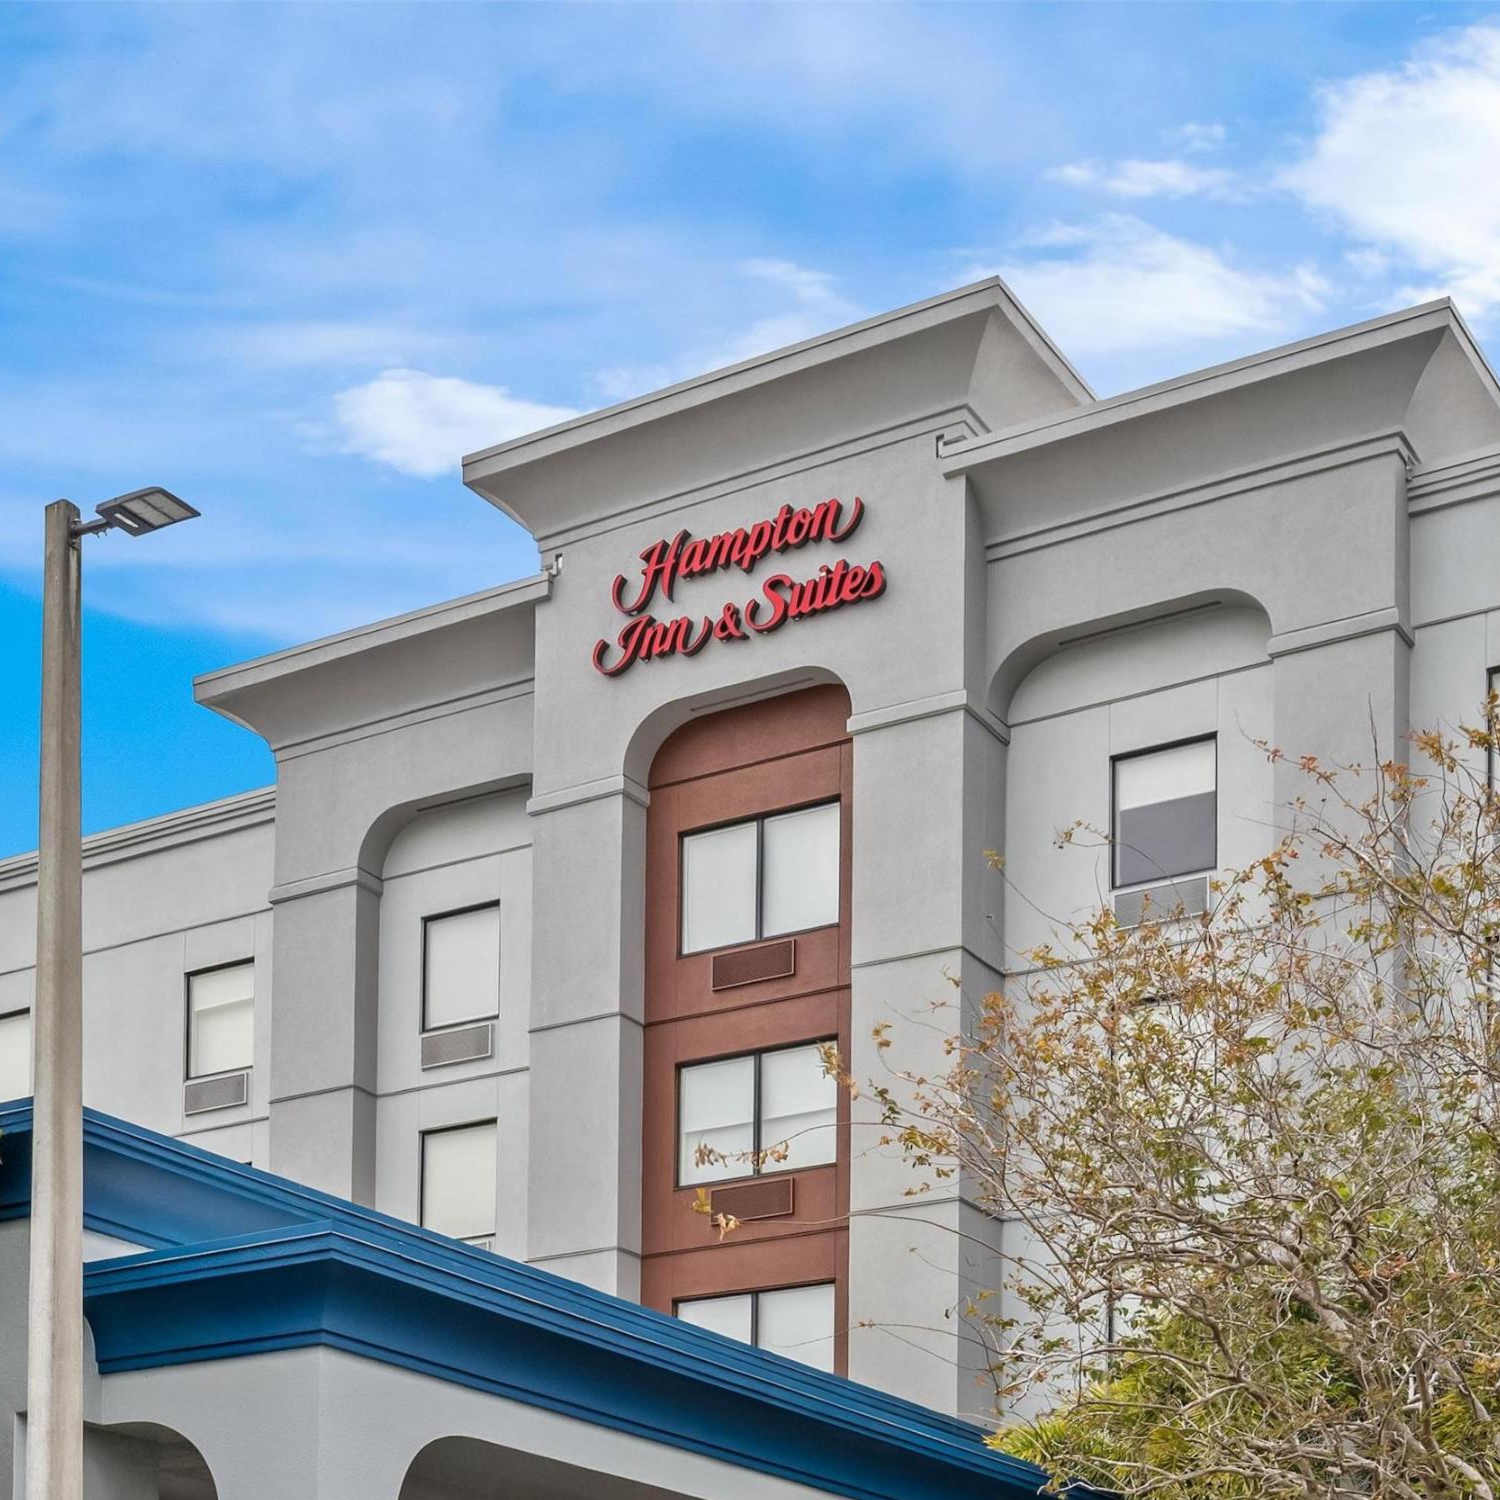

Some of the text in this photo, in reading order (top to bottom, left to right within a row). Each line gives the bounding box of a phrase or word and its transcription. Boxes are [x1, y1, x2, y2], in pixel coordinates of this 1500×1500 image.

[612, 497, 865, 615] Hampton
[592, 558, 887, 678] Inn & Suites
